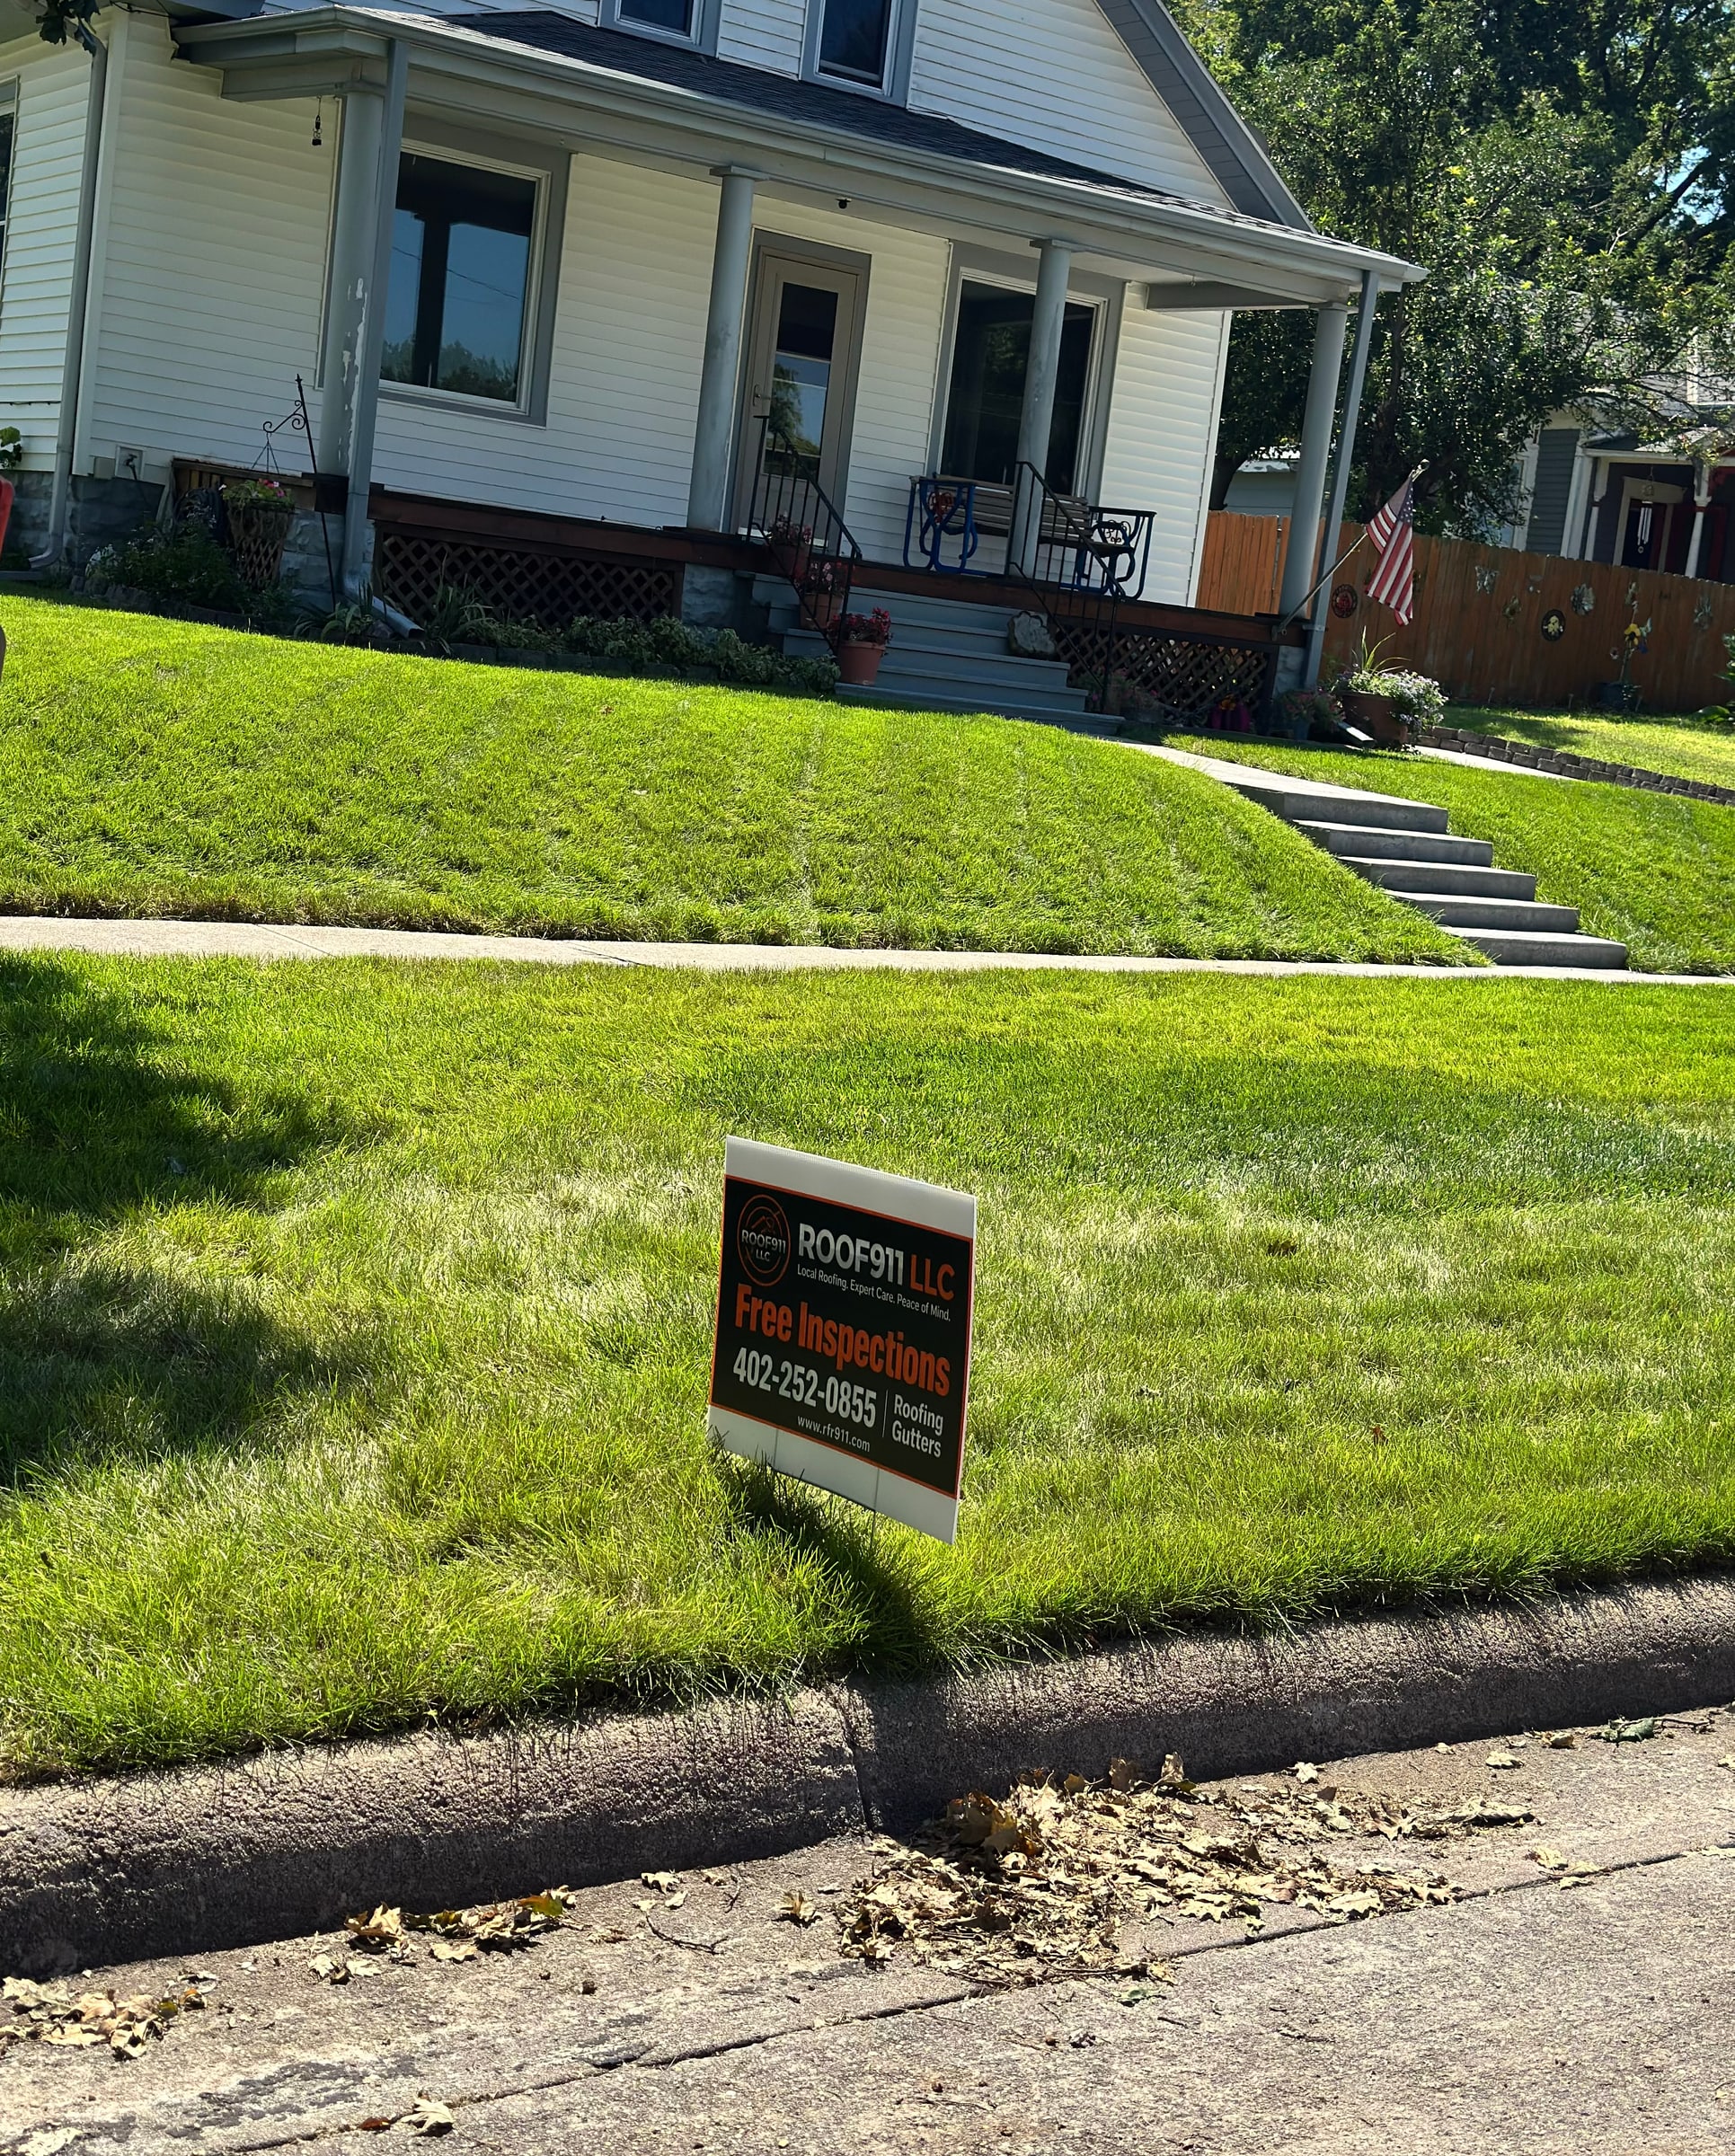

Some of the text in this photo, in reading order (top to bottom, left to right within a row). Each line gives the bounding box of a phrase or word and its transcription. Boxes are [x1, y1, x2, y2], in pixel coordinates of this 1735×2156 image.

[741, 1229, 786, 1255] ROOF911
[756, 1249, 771, 1262] LLC
[798, 1223, 955, 1301] ROOF911 LLC
[797, 1264, 952, 1321] Local Roofing. Expert Care. Peace of Mind.
[735, 1283, 951, 1397] Free Inspections
[732, 1347, 877, 1428] 402-252-0855
[797, 1415, 871, 1453] www.rfr911.com
[894, 1394, 943, 1436] Roofing
[891, 1420, 942, 1458] Gutters
